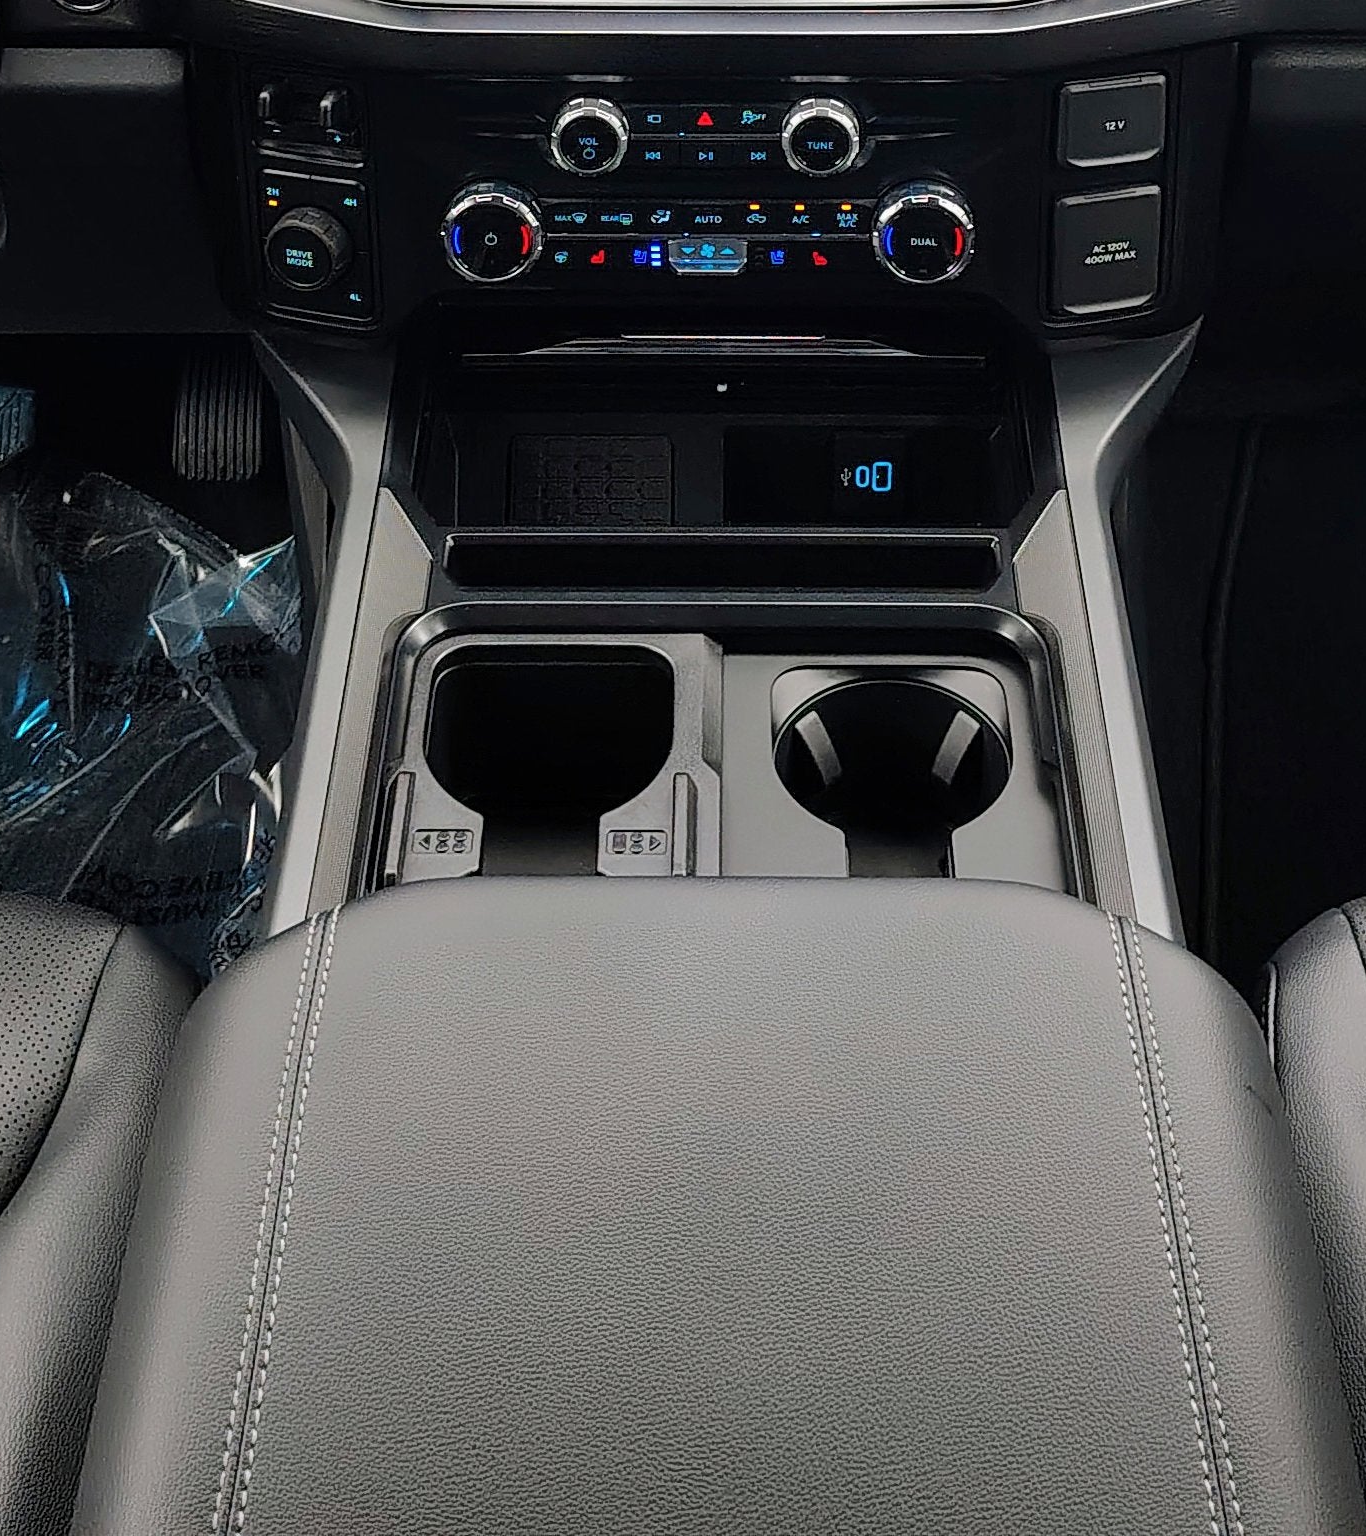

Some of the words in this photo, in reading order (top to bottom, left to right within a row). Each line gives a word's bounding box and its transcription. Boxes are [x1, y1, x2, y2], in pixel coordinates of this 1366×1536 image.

[1105, 120, 1115, 131] 12
[1116, 120, 1125, 130] V
[578, 138, 599, 146] VOL
[807, 141, 834, 150] TUNE
[266, 187, 280, 196] 2H
[343, 197, 357, 207] 4H
[695, 215, 722, 224] AUTO
[792, 215, 810, 224] A/C
[837, 213, 858, 222] MAX
[839, 220, 857, 228] A/C
[910, 238, 938, 246] DUAL
[1092, 244, 1105, 253] AC
[1107, 241, 1129, 252] 120V
[286, 248, 313, 259] DRIVE
[1085, 254, 1113, 264] 400W
[1115, 250, 1136, 261] MAX
[286, 257, 314, 268] MODE
[349, 293, 362, 302] 4L
